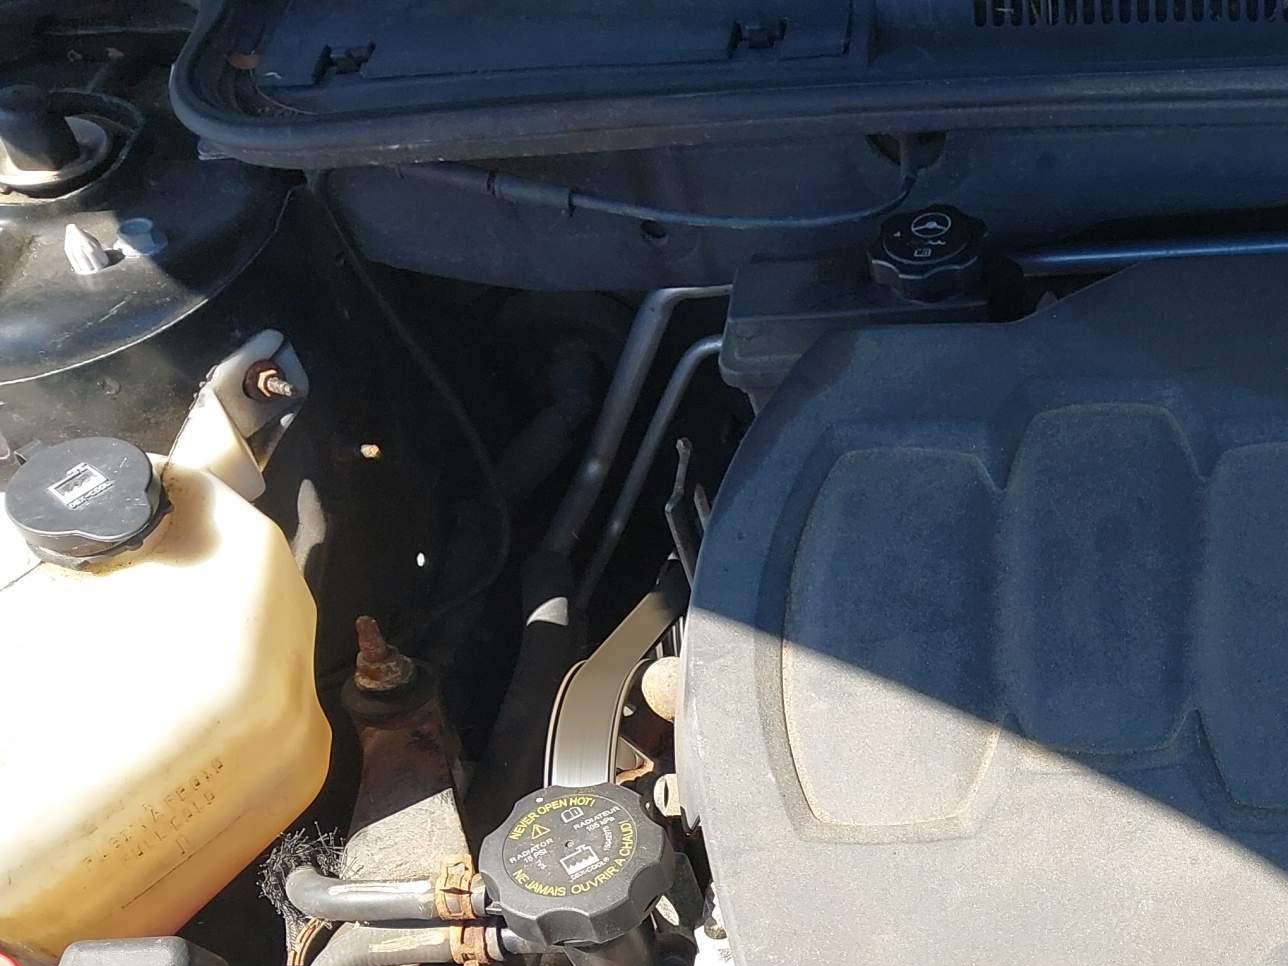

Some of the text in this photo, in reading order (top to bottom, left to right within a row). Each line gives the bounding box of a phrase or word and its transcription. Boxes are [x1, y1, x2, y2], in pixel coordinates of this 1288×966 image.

[509, 797, 596, 840] NEVER OPEN HOT!
[573, 806, 621, 830] RADIATEUR
[509, 838, 554, 864] RADIATOR
[513, 869, 530, 884] NE
[525, 880, 567, 896] JAMAIS
[571, 865, 620, 894] OUVRIR
[618, 819, 634, 857] CHAUD!
